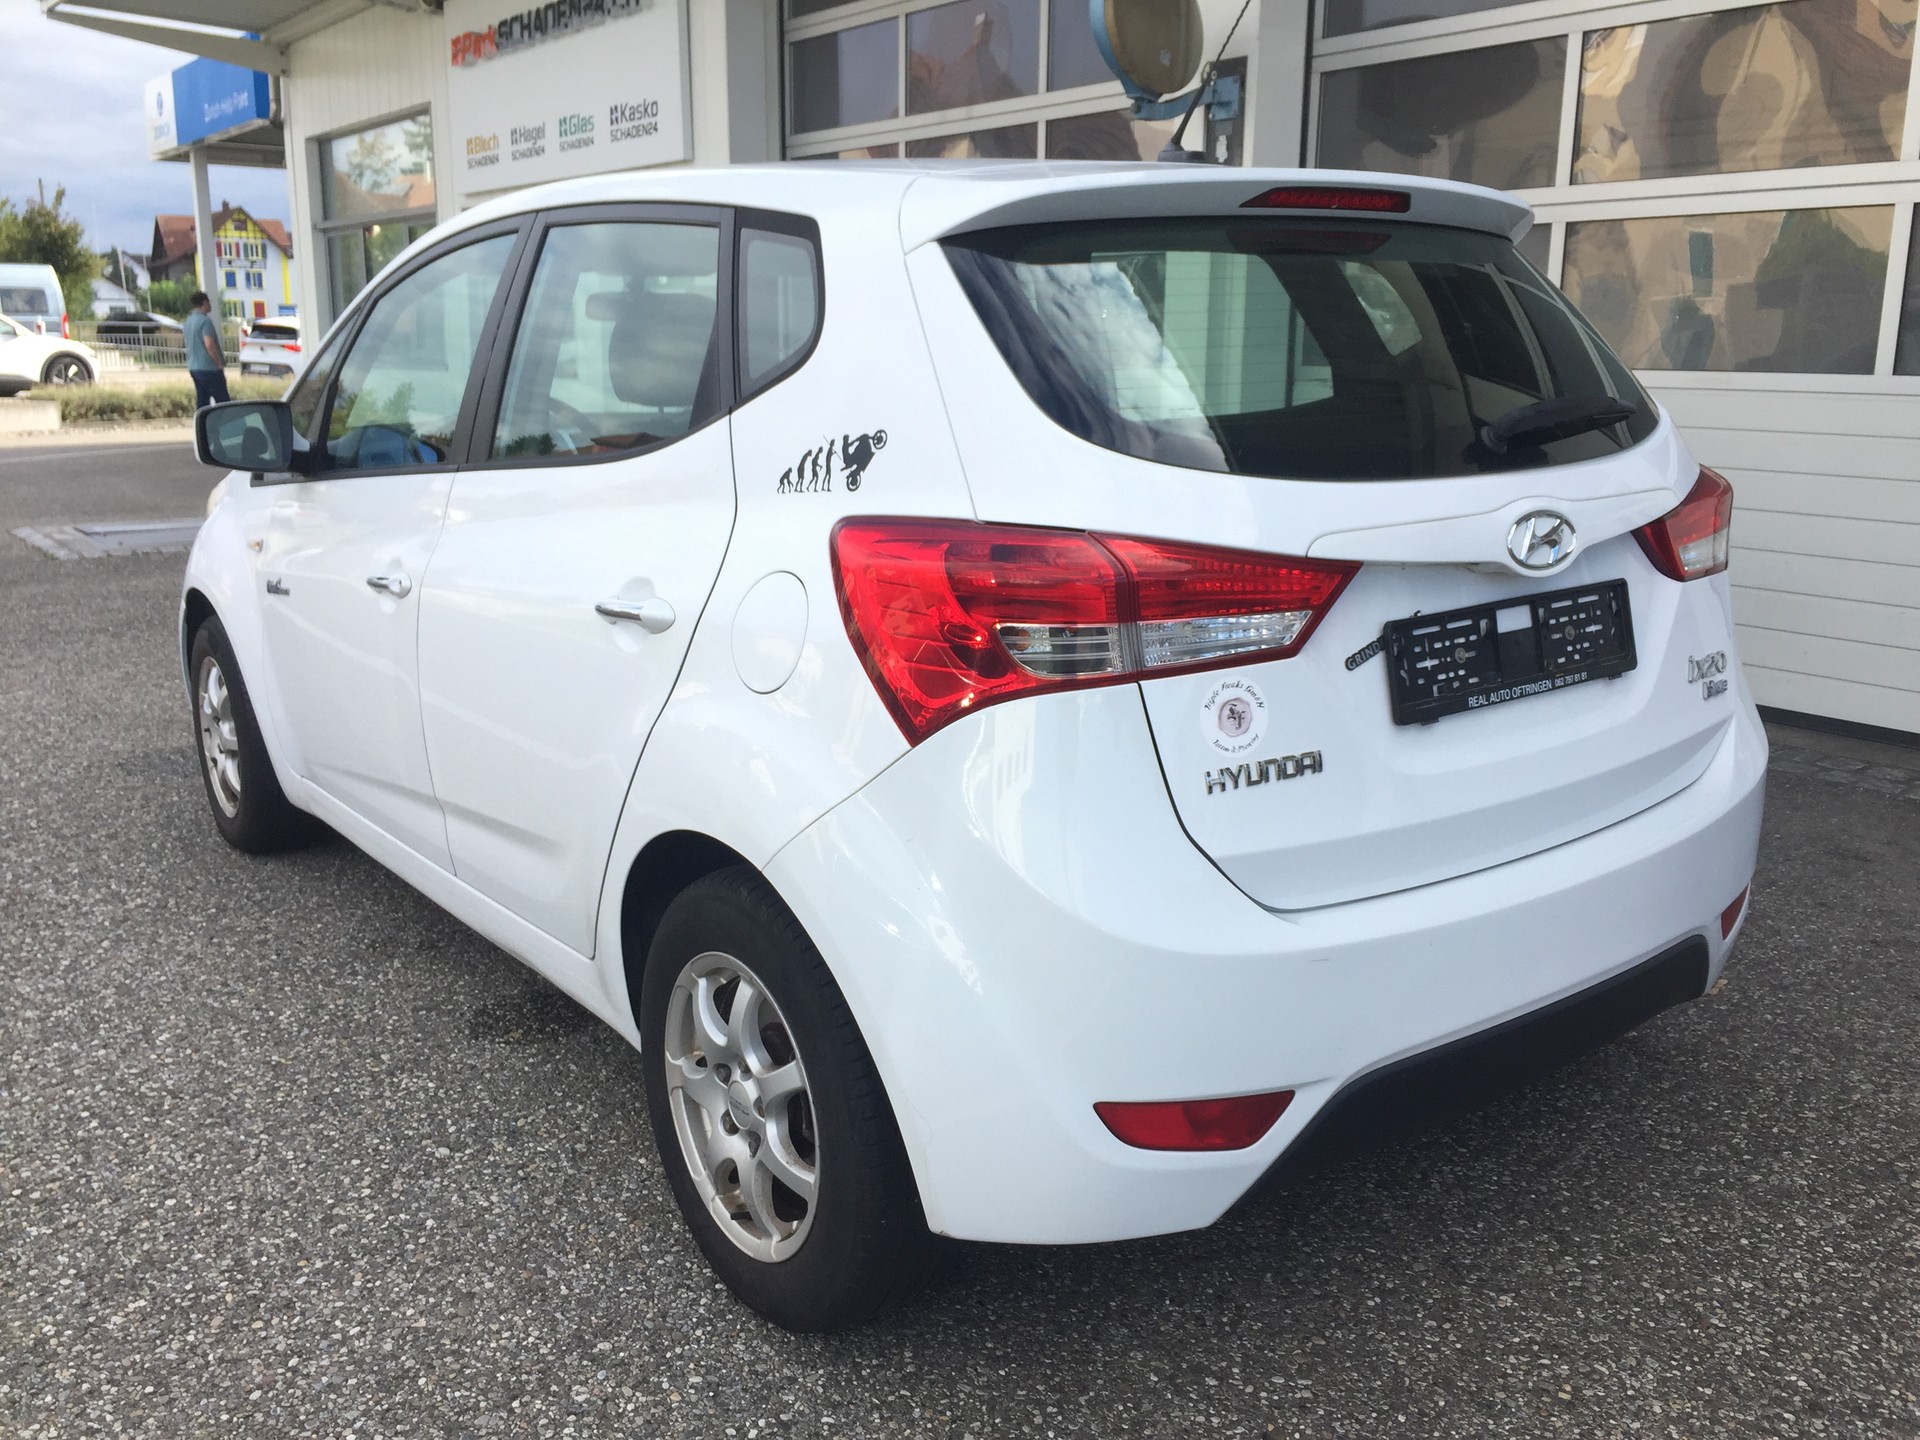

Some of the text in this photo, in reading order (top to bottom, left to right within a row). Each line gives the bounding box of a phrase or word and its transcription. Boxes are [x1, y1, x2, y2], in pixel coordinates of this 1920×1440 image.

[620, 98, 658, 124] Kasko
[519, 122, 545, 146] Hagel
[569, 113, 594, 136] Glas
[609, 121, 658, 143] SCHADEN24
[474, 132, 499, 154] Blech
[1468, 695, 1489, 708] REAL
[1489, 690, 1511, 703] AUTO
[1511, 679, 1552, 698] OFTRINGEN
[1204, 749, 1323, 795] HYUNDAI
